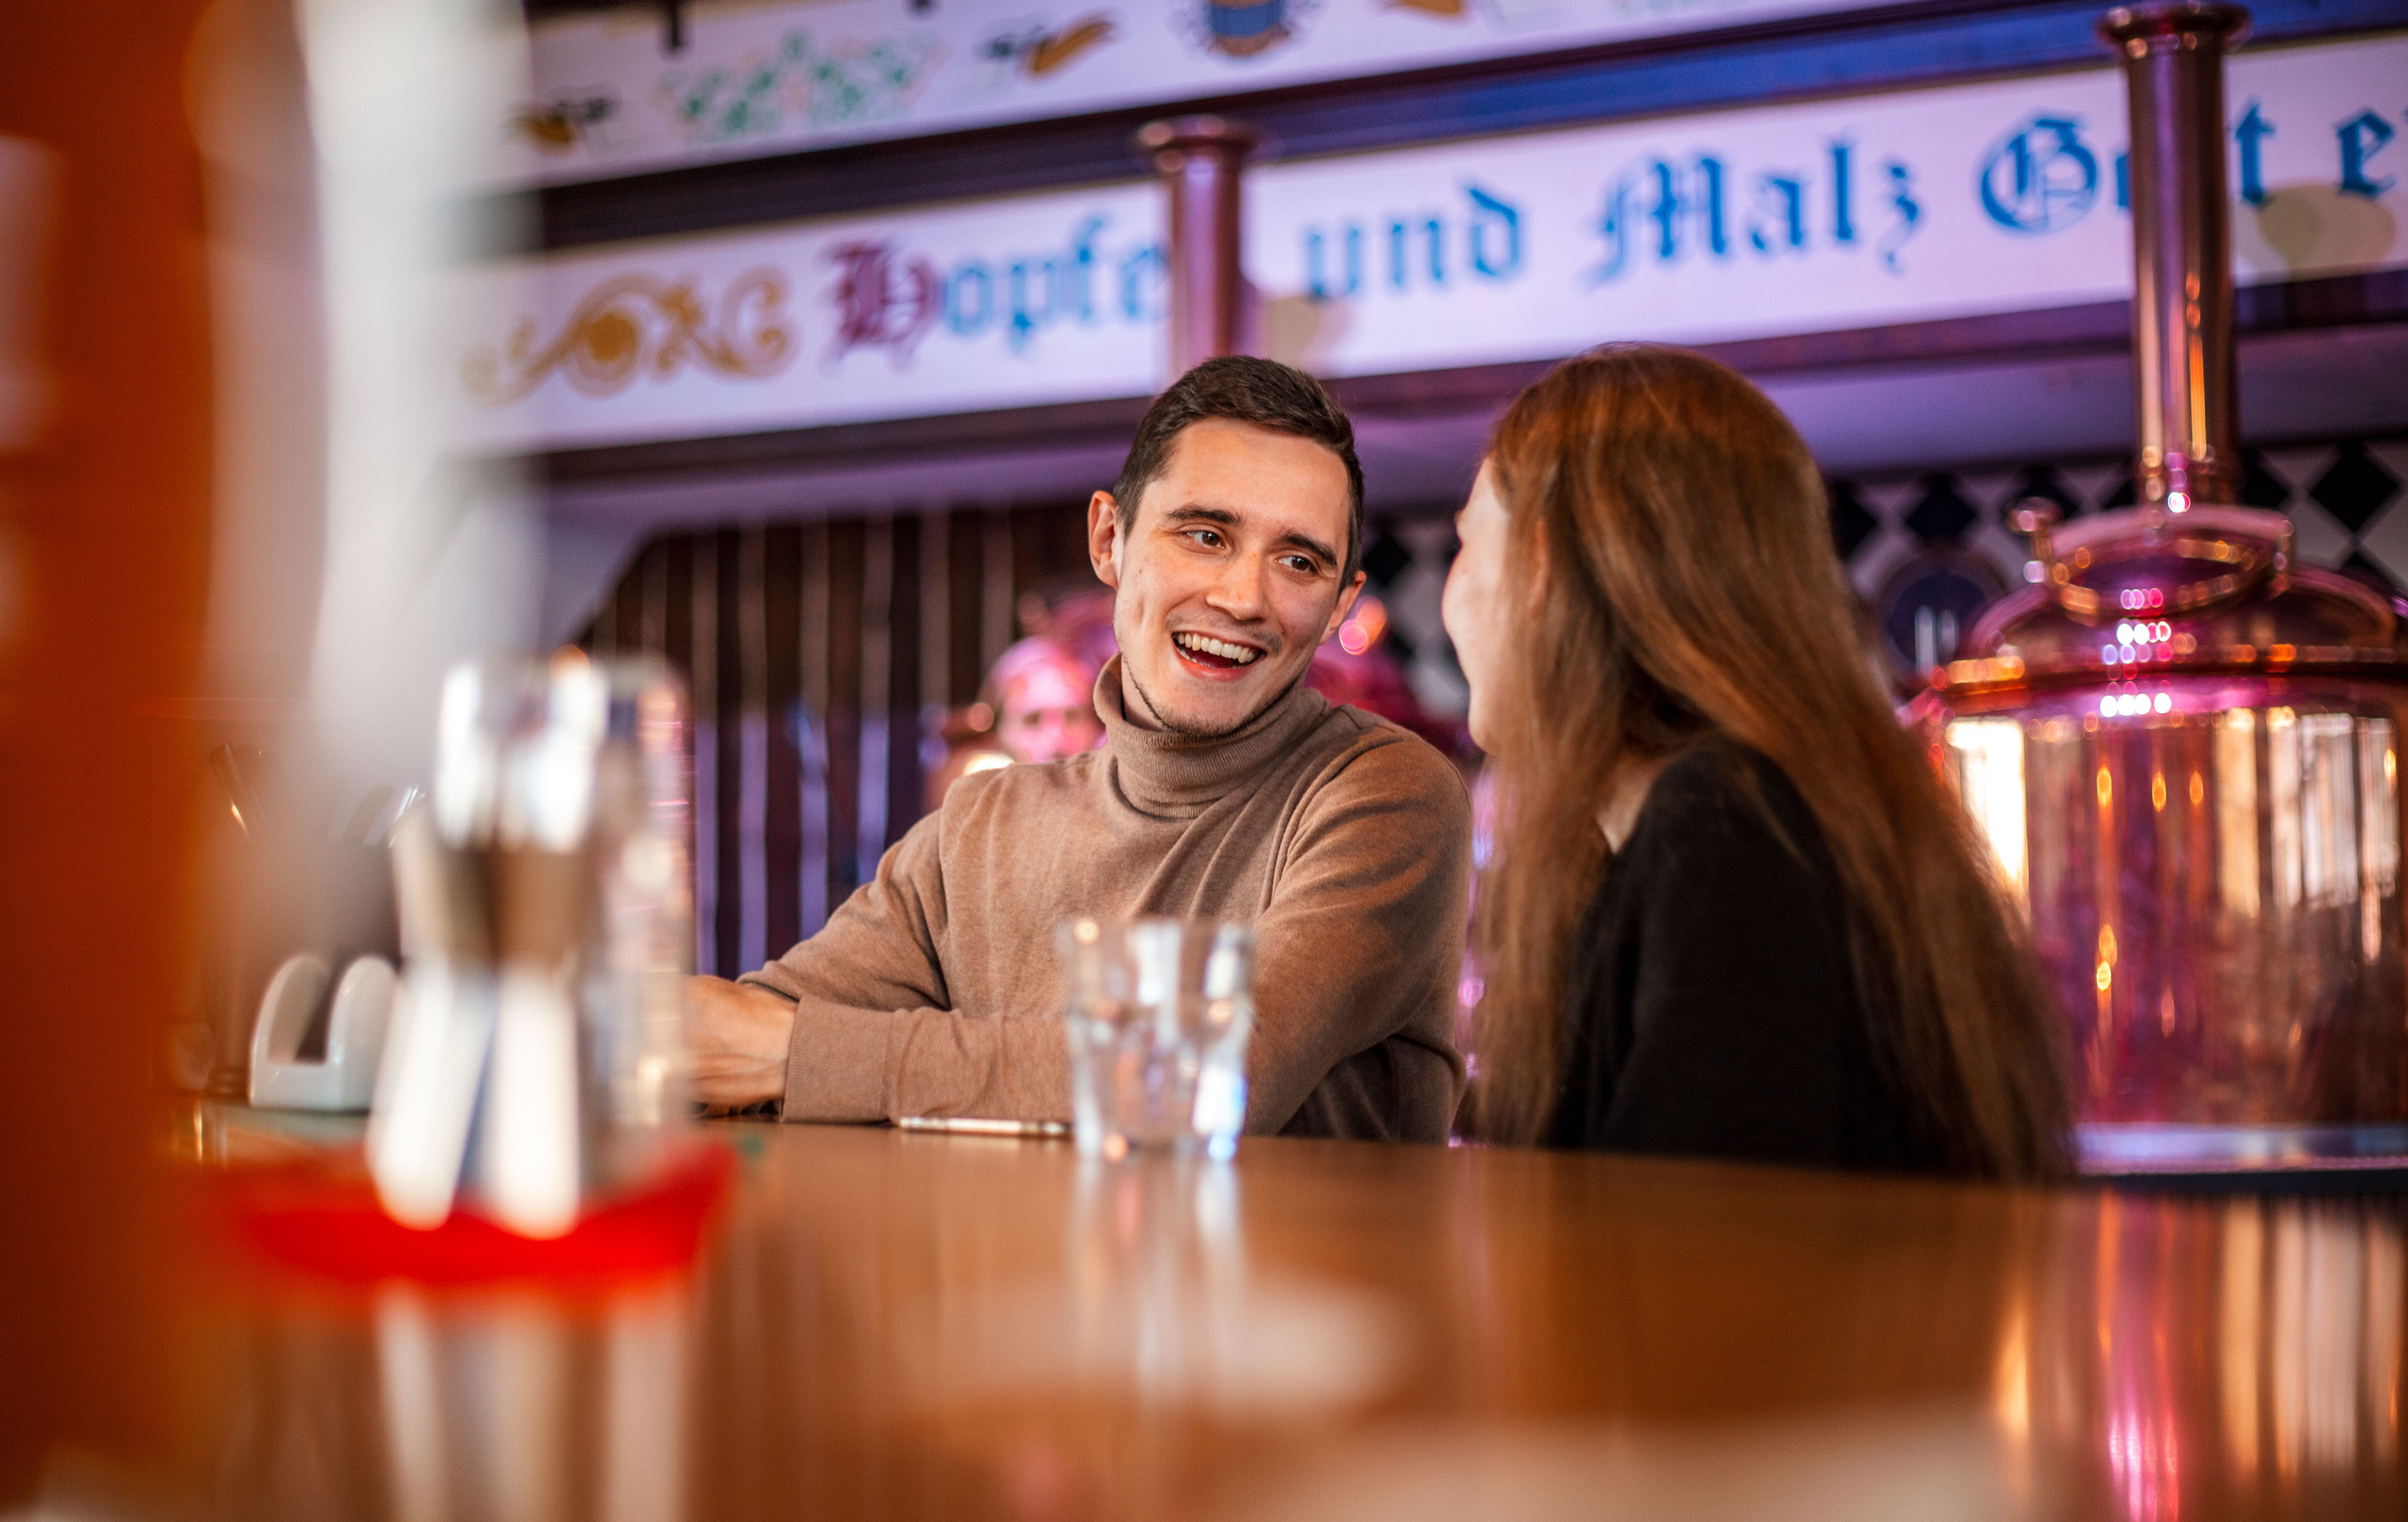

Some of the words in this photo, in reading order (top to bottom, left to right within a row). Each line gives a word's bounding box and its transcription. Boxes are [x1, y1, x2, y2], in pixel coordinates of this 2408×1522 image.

[820, 213, 1171, 369] Hopfe
[1303, 179, 1520, 299] und
[1592, 139, 1919, 285] Malz
[1978, 100, 2274, 235] Gt
